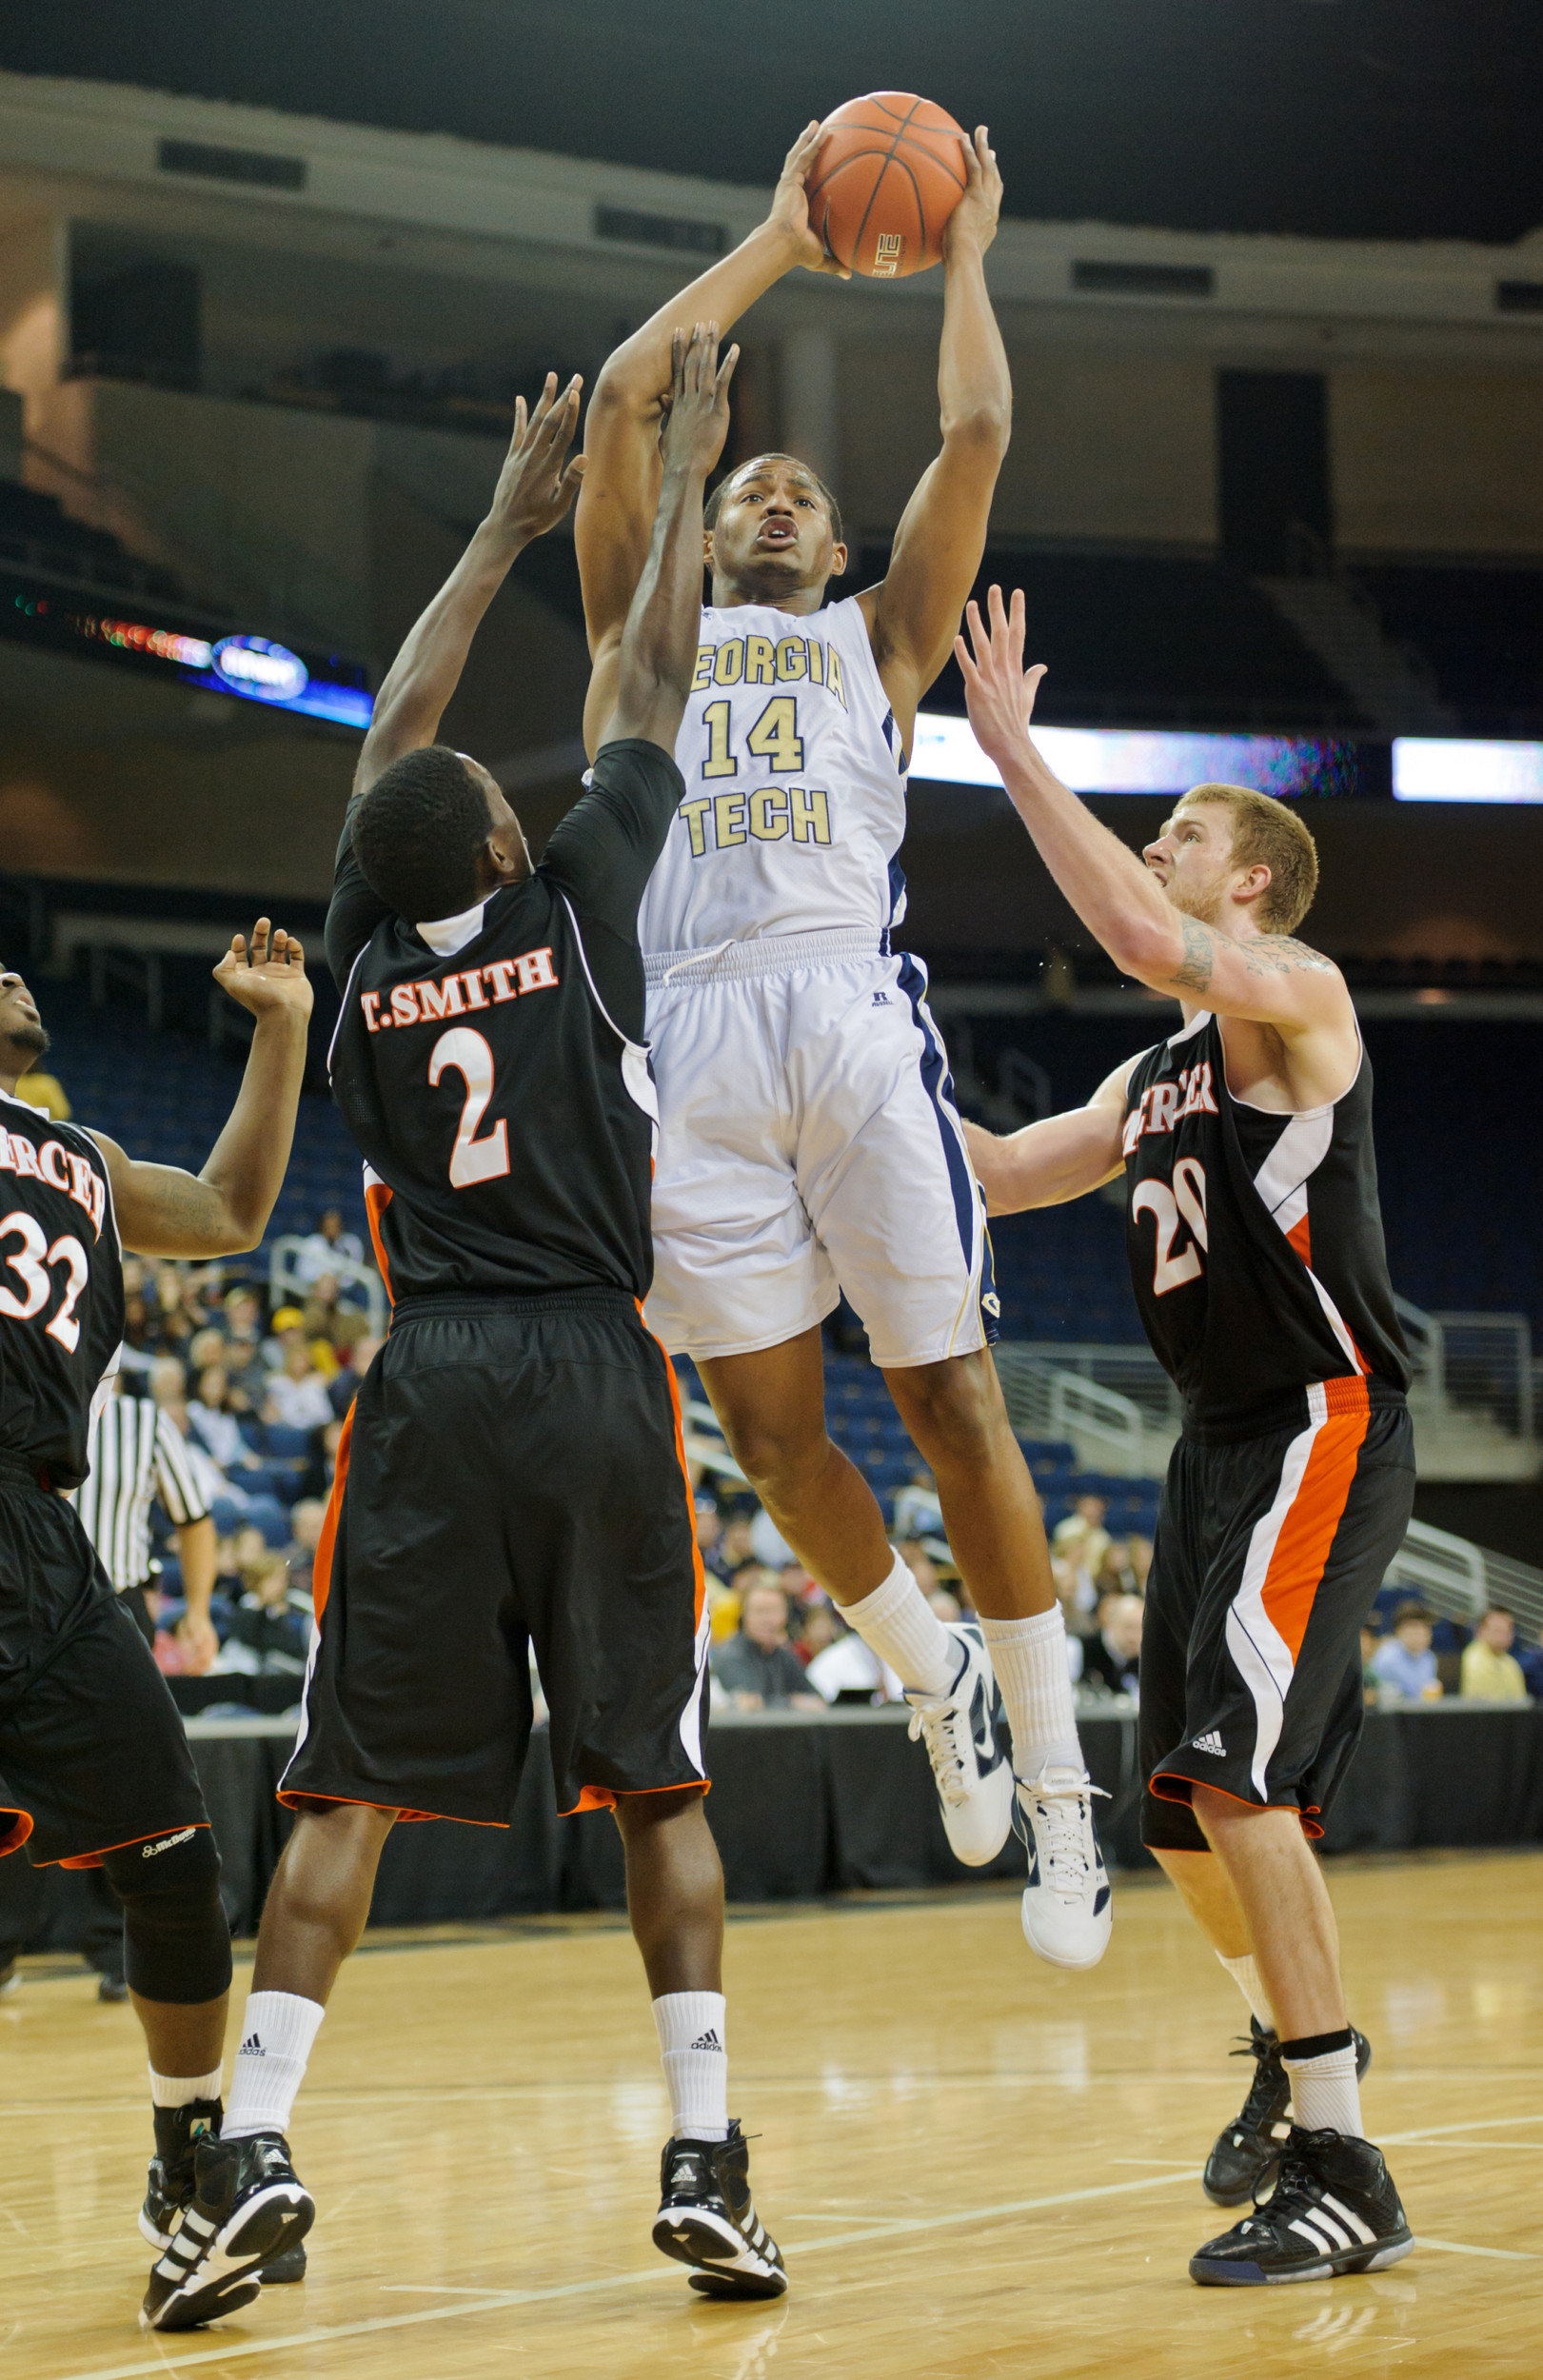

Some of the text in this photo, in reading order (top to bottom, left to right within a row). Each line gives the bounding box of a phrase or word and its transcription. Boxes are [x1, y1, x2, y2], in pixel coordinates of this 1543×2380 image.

[690, 635, 848, 714] EORGIA
[702, 696, 804, 780] 14
[679, 787, 832, 858] TECH
[361, 947, 559, 1033] T.SMITH
[428, 1026, 511, 1190] 2
[1132, 1157, 1209, 1298] 20
[0, 1211, 89, 1355] 32
[1192, 1740, 1227, 1757] adidas
